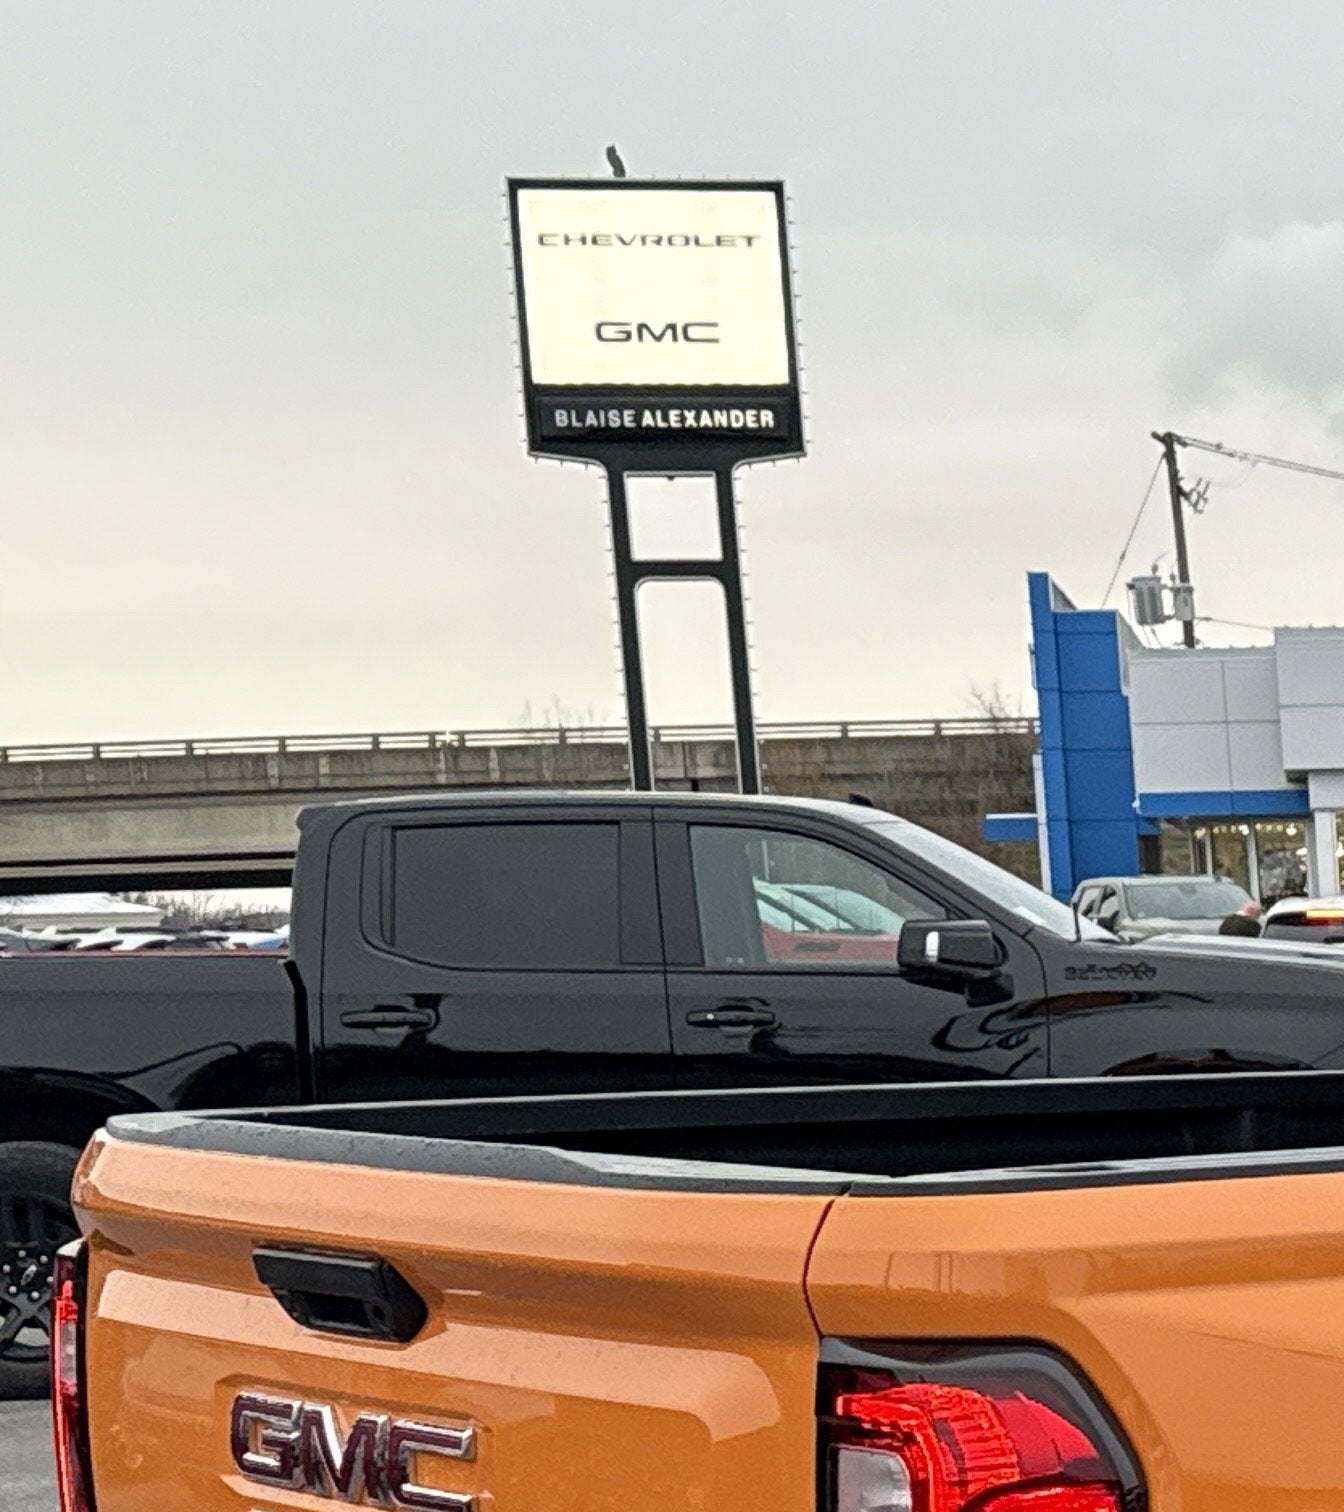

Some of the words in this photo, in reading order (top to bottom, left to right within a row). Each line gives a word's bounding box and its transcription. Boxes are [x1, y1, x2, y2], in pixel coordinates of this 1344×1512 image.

[537, 232, 761, 248] CHEVROLET
[595, 321, 720, 343] GMC
[555, 408, 636, 429] BLAISE
[641, 408, 774, 429] ALEXANDER
